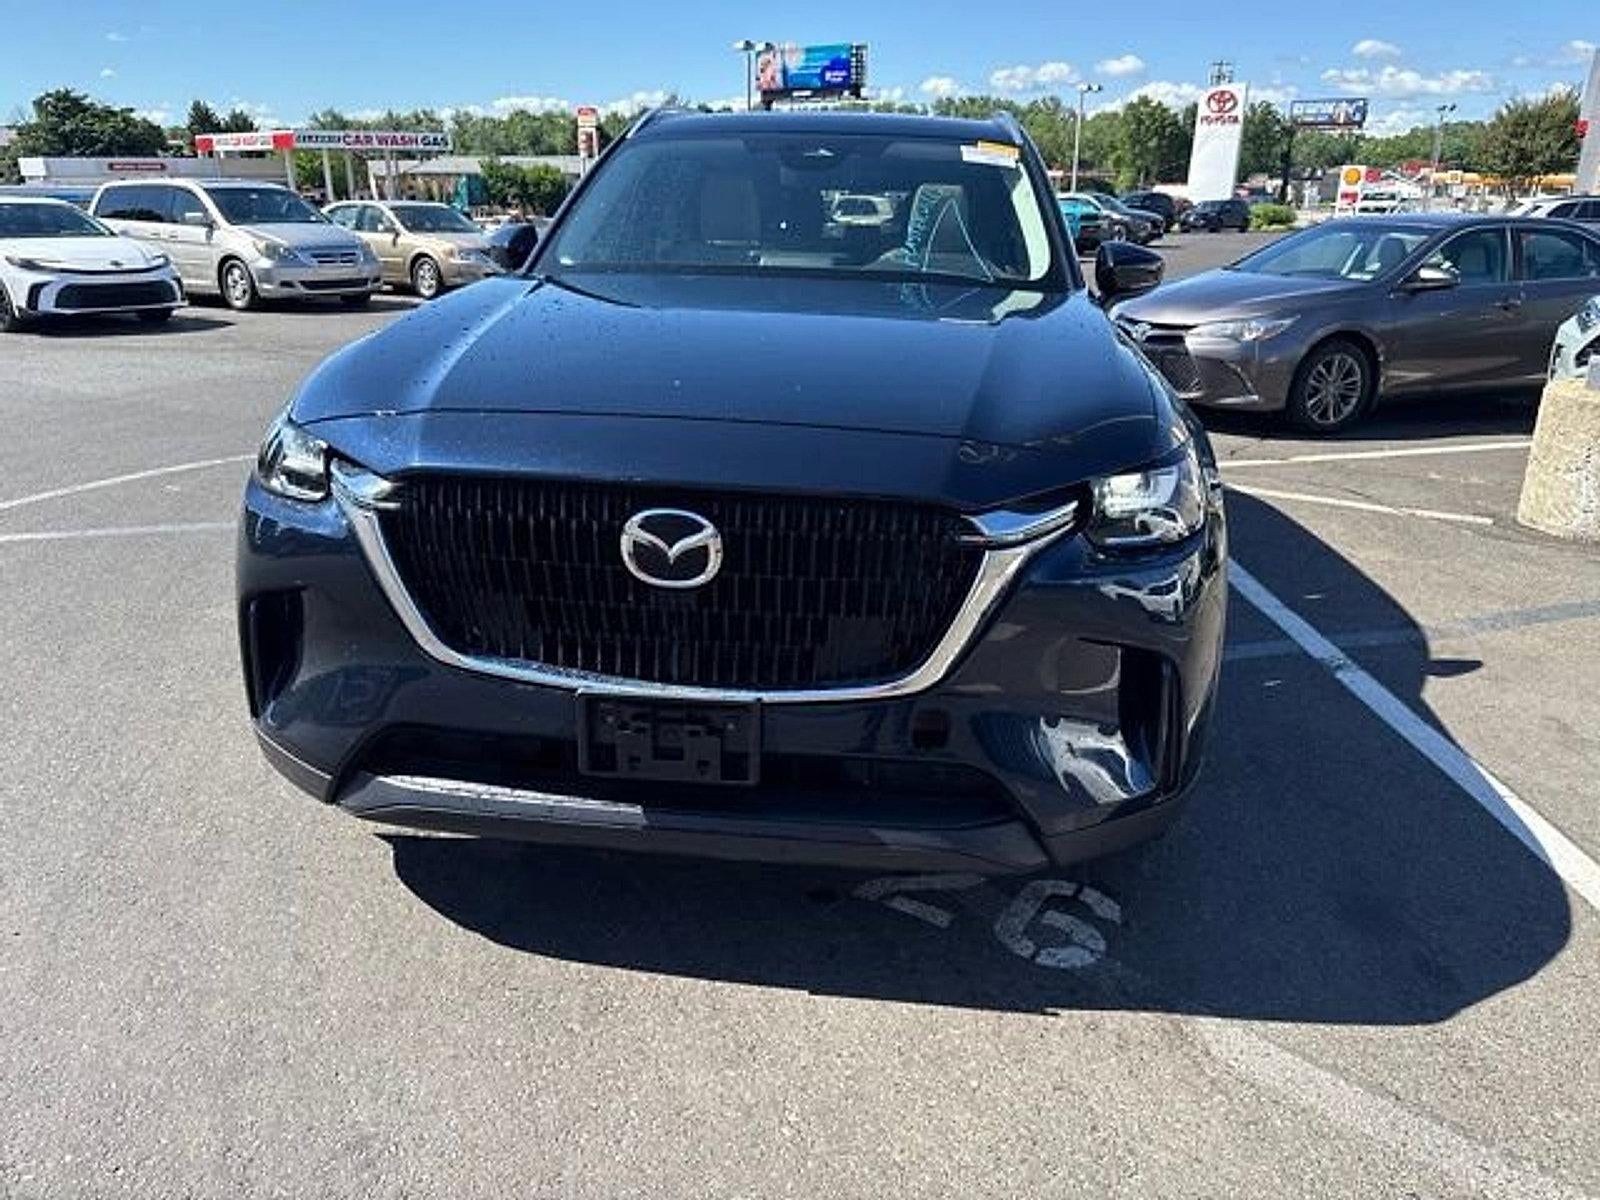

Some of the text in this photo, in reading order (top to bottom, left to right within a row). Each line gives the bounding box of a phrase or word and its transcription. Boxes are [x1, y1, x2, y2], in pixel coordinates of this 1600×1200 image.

[1200, 115, 1239, 126] TOYOTA
[342, 134, 374, 146] CAR
[375, 134, 419, 147] WASH
[420, 134, 449, 147] GAS
